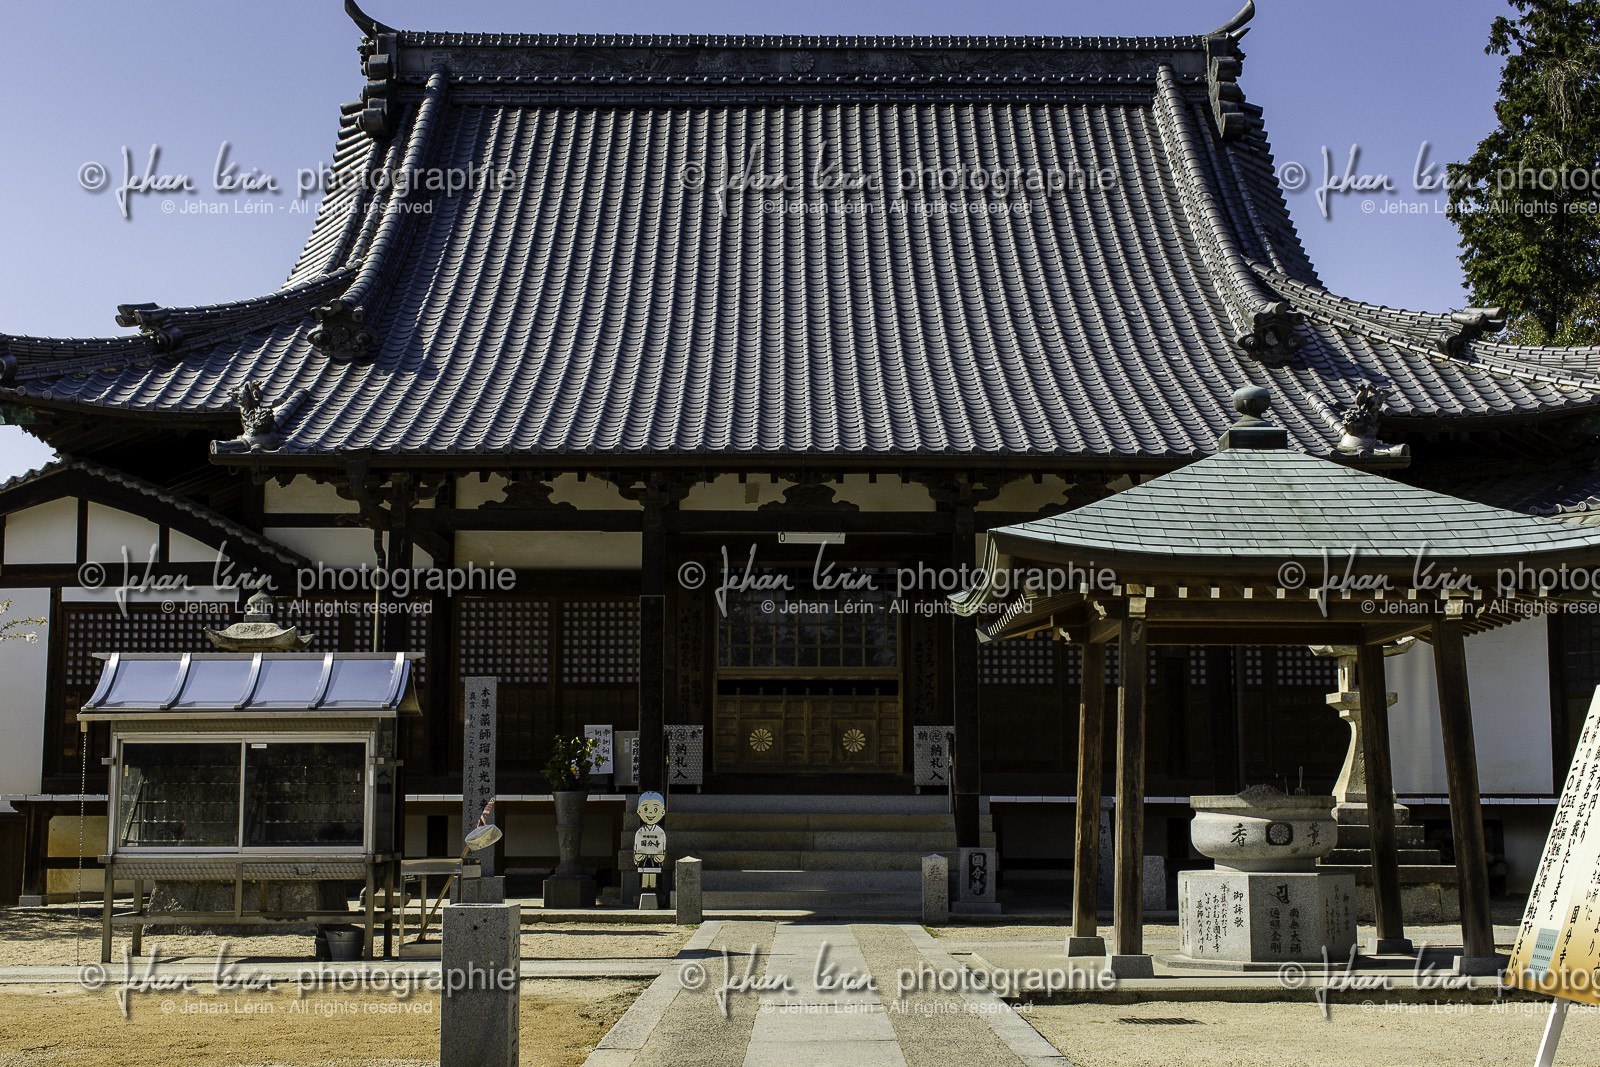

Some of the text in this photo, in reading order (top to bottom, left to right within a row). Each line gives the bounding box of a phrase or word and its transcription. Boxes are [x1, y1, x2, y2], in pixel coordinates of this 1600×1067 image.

[929, 744, 944, 780] 納札入
[1231, 823, 1247, 847] 香
[1269, 907, 1282, 953] 遍照金剛
[1289, 908, 1302, 954] 南無大師
